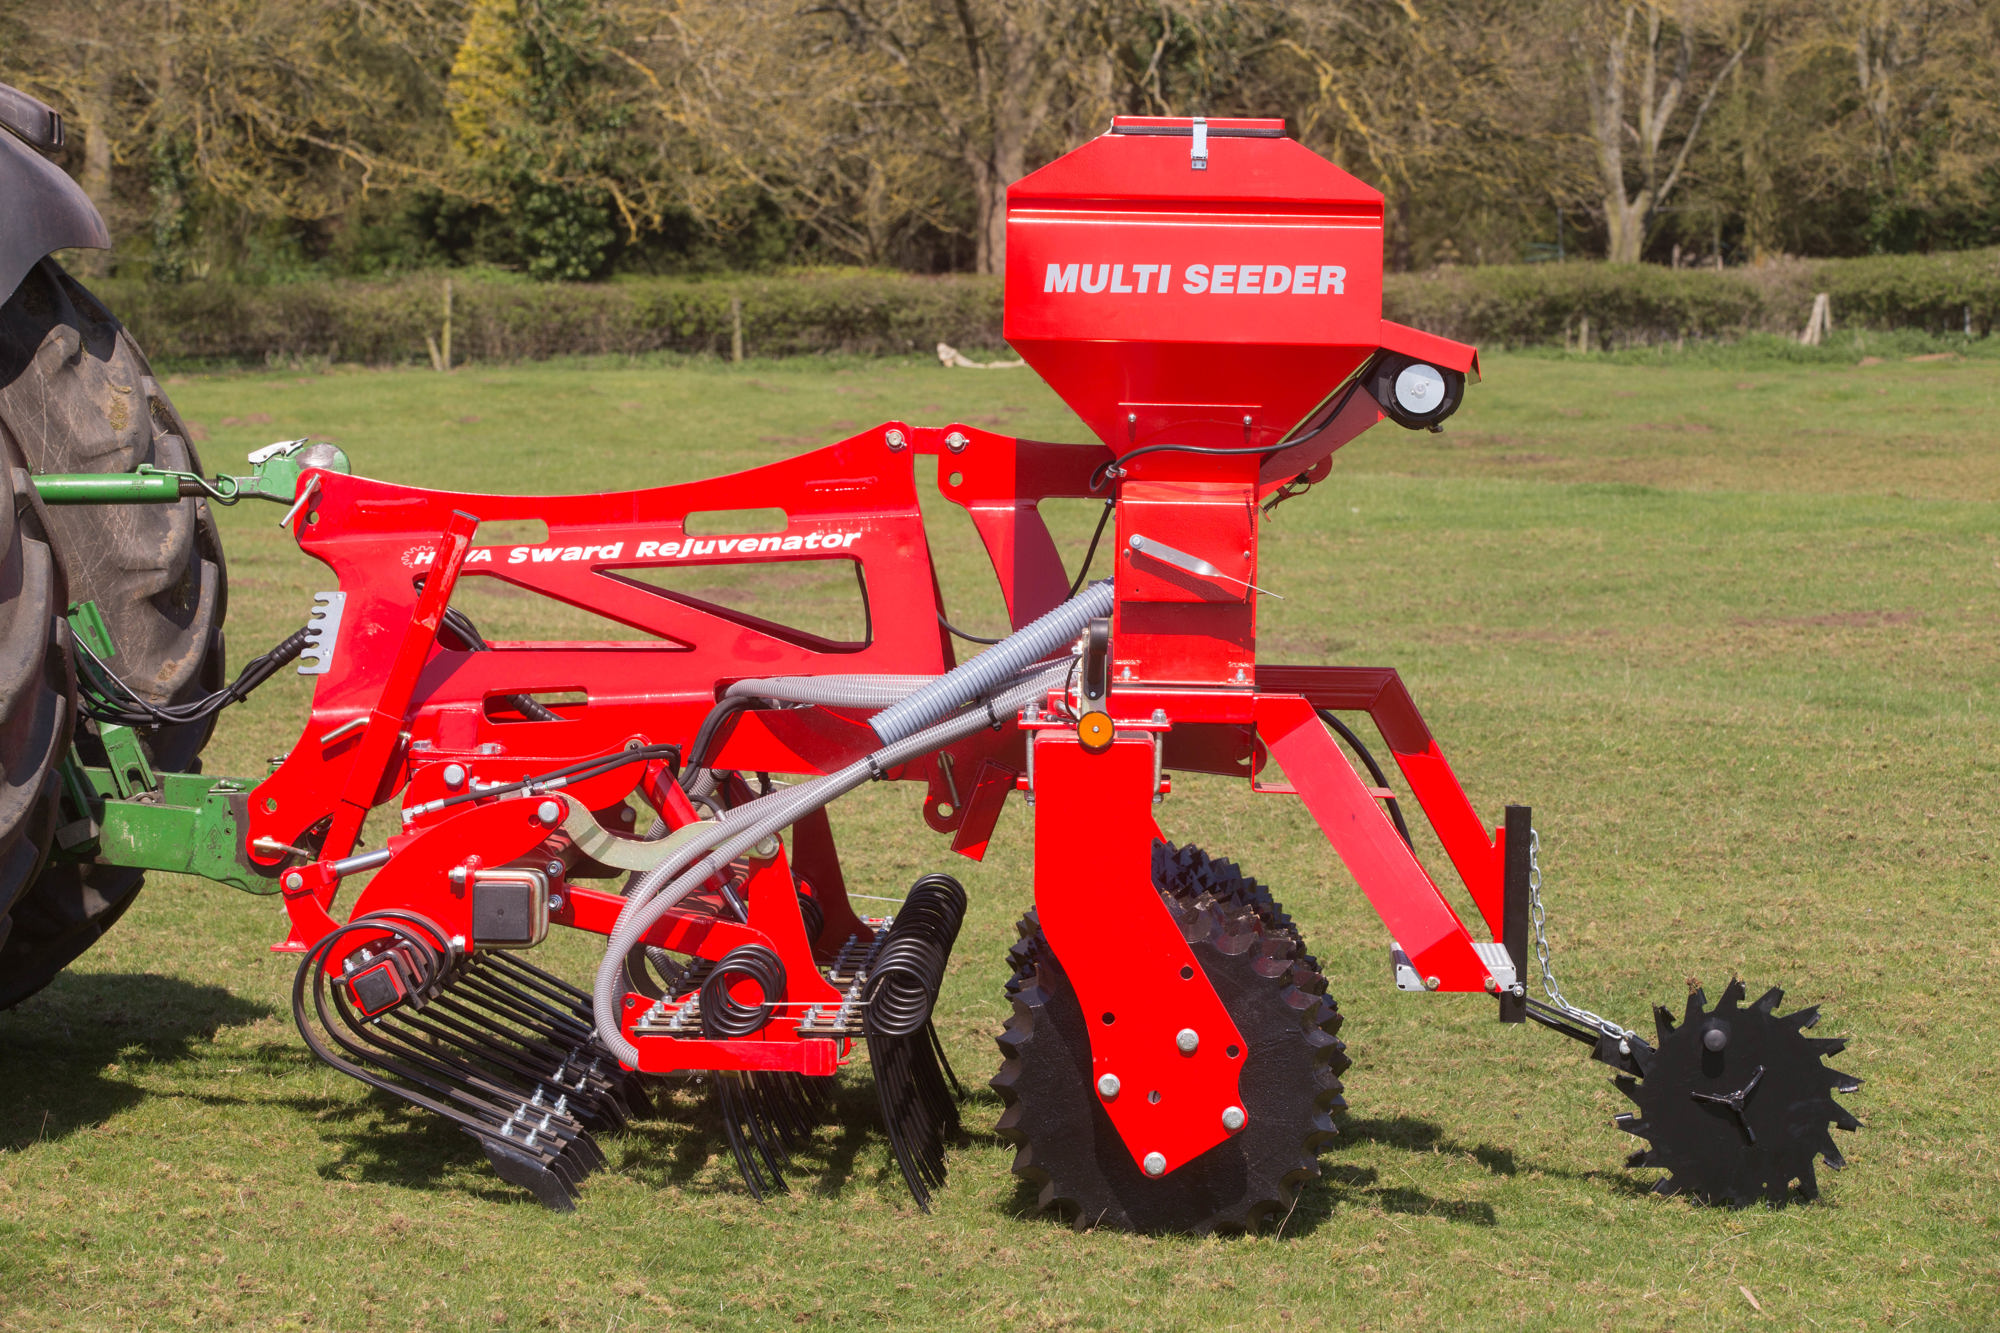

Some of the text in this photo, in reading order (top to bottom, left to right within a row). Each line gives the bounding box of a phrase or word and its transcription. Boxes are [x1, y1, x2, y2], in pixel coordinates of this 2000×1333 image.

[1043, 263, 1347, 295] MULTI SEEDER
[507, 542, 624, 564] Sward
[635, 531, 862, 558] Rejuvenator
